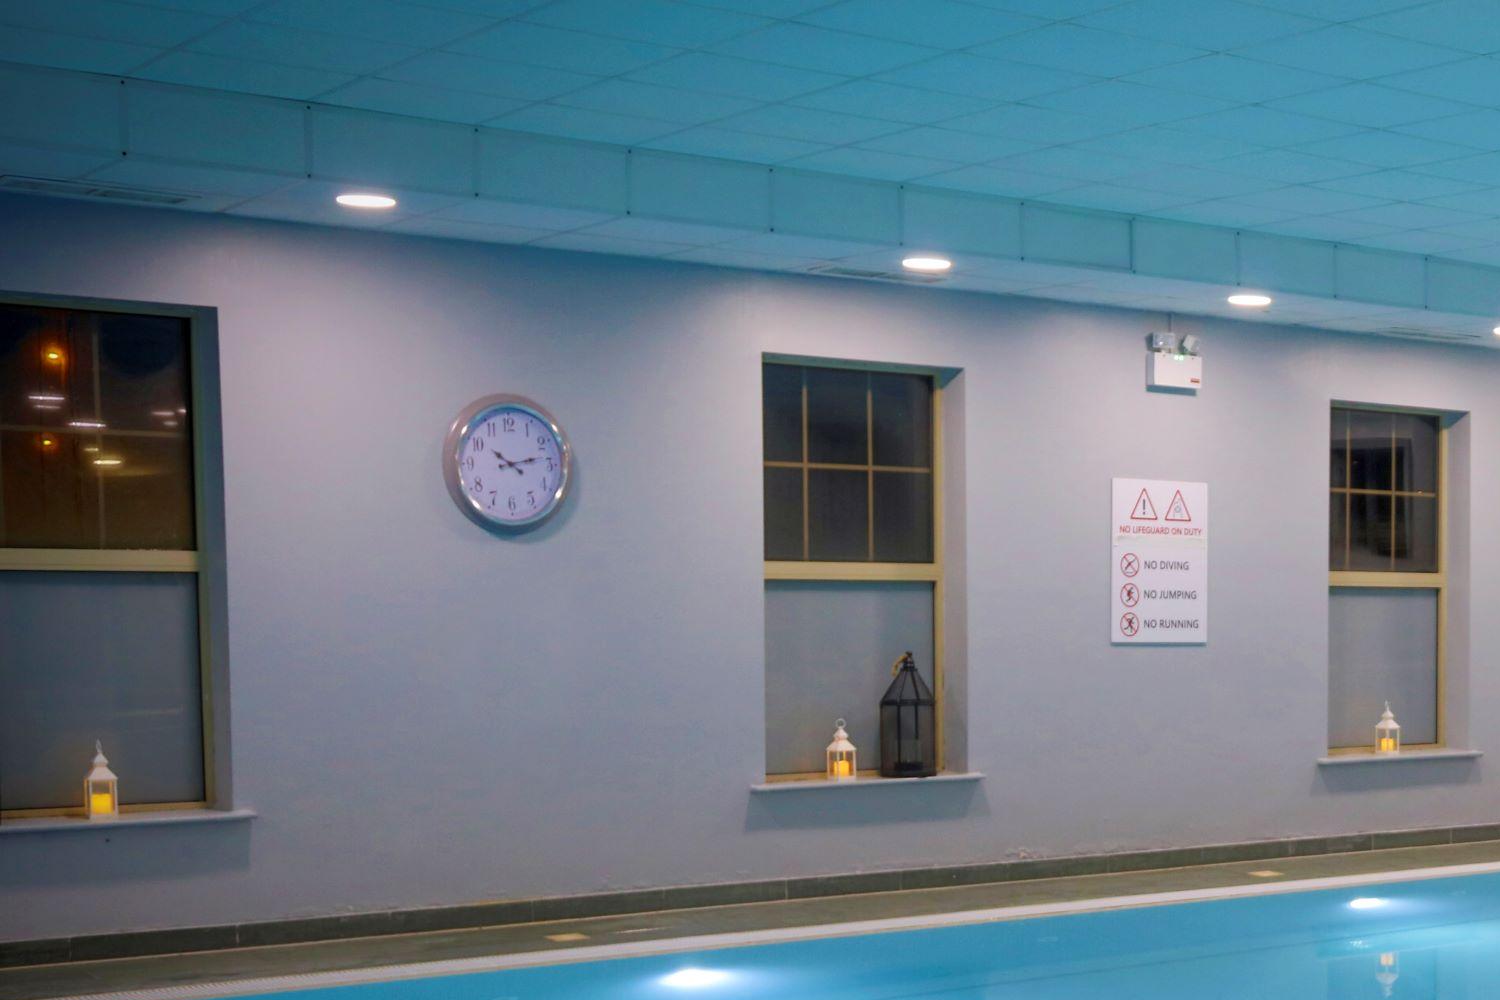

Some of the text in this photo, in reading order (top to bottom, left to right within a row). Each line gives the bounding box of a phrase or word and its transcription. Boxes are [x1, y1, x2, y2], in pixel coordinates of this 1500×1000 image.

[503, 418, 515, 433] 12
[473, 437, 484, 452] 10
[537, 436, 546, 450] 2
[467, 456, 474, 471] 9
[474, 477, 483, 492] 8
[489, 490, 497, 506] 7
[508, 496, 516, 511] 6
[1120, 525, 1202, 536] NO LIFEGUARD ON DUTY
[1144, 560, 1189, 571] NO DIVING
[1144, 590, 1197, 600] NO JUMPING
[1144, 619, 1199, 629] NO RUNNING
